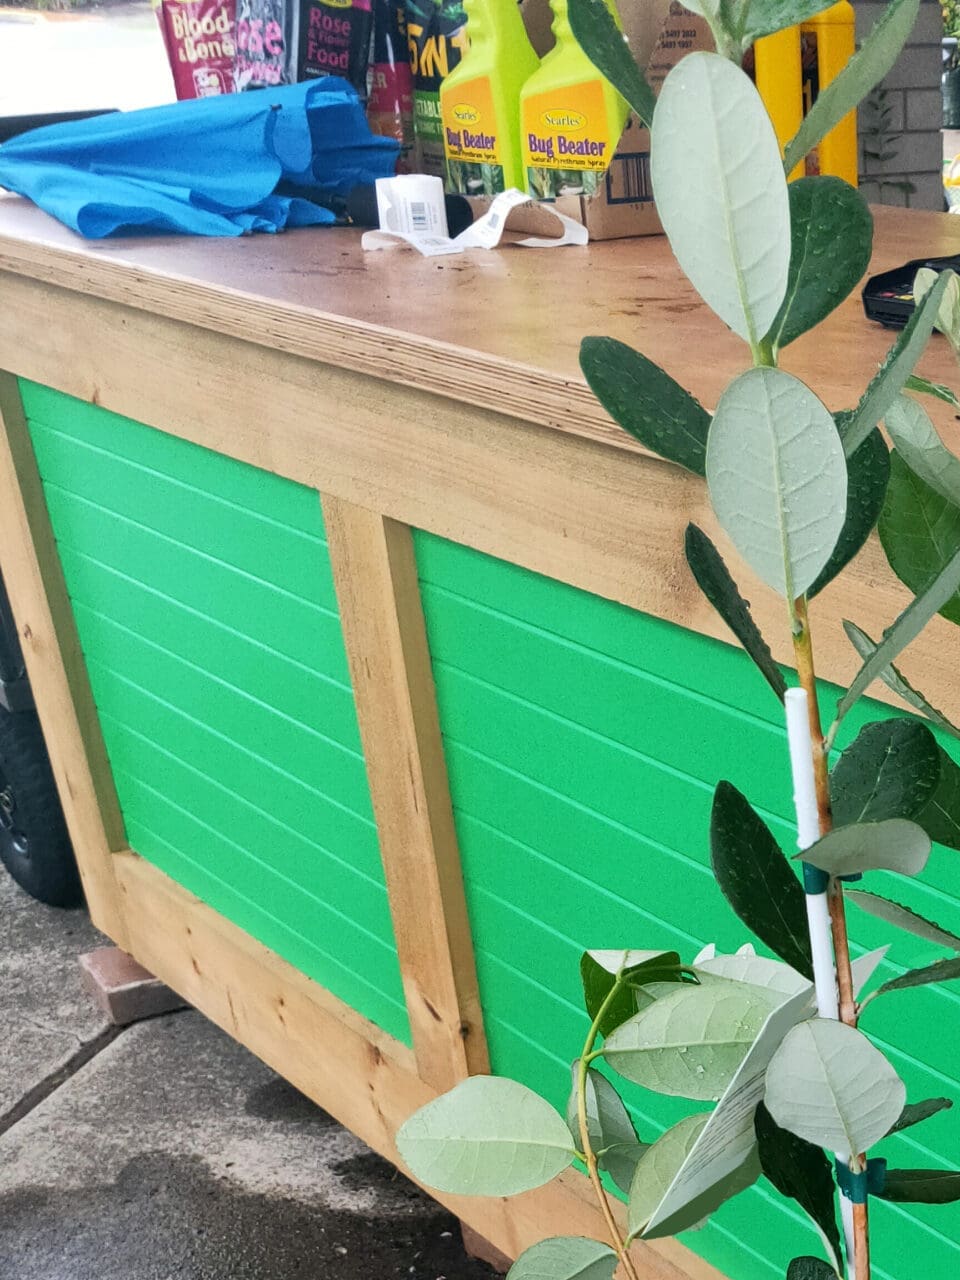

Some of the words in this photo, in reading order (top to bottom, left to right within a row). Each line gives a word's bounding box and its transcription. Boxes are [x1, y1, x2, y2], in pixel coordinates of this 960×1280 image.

[171, 6, 230, 39] Blood
[309, 7, 351, 36] Rose
[307, 40, 349, 69] Food
[454, 111, 477, 121] Searles
[545, 115, 582, 126] Searles
[446, 128, 463, 151] Bug
[463, 130, 496, 150] Beater
[528, 134, 555, 158] Bug
[557, 136, 606, 156] Beater
